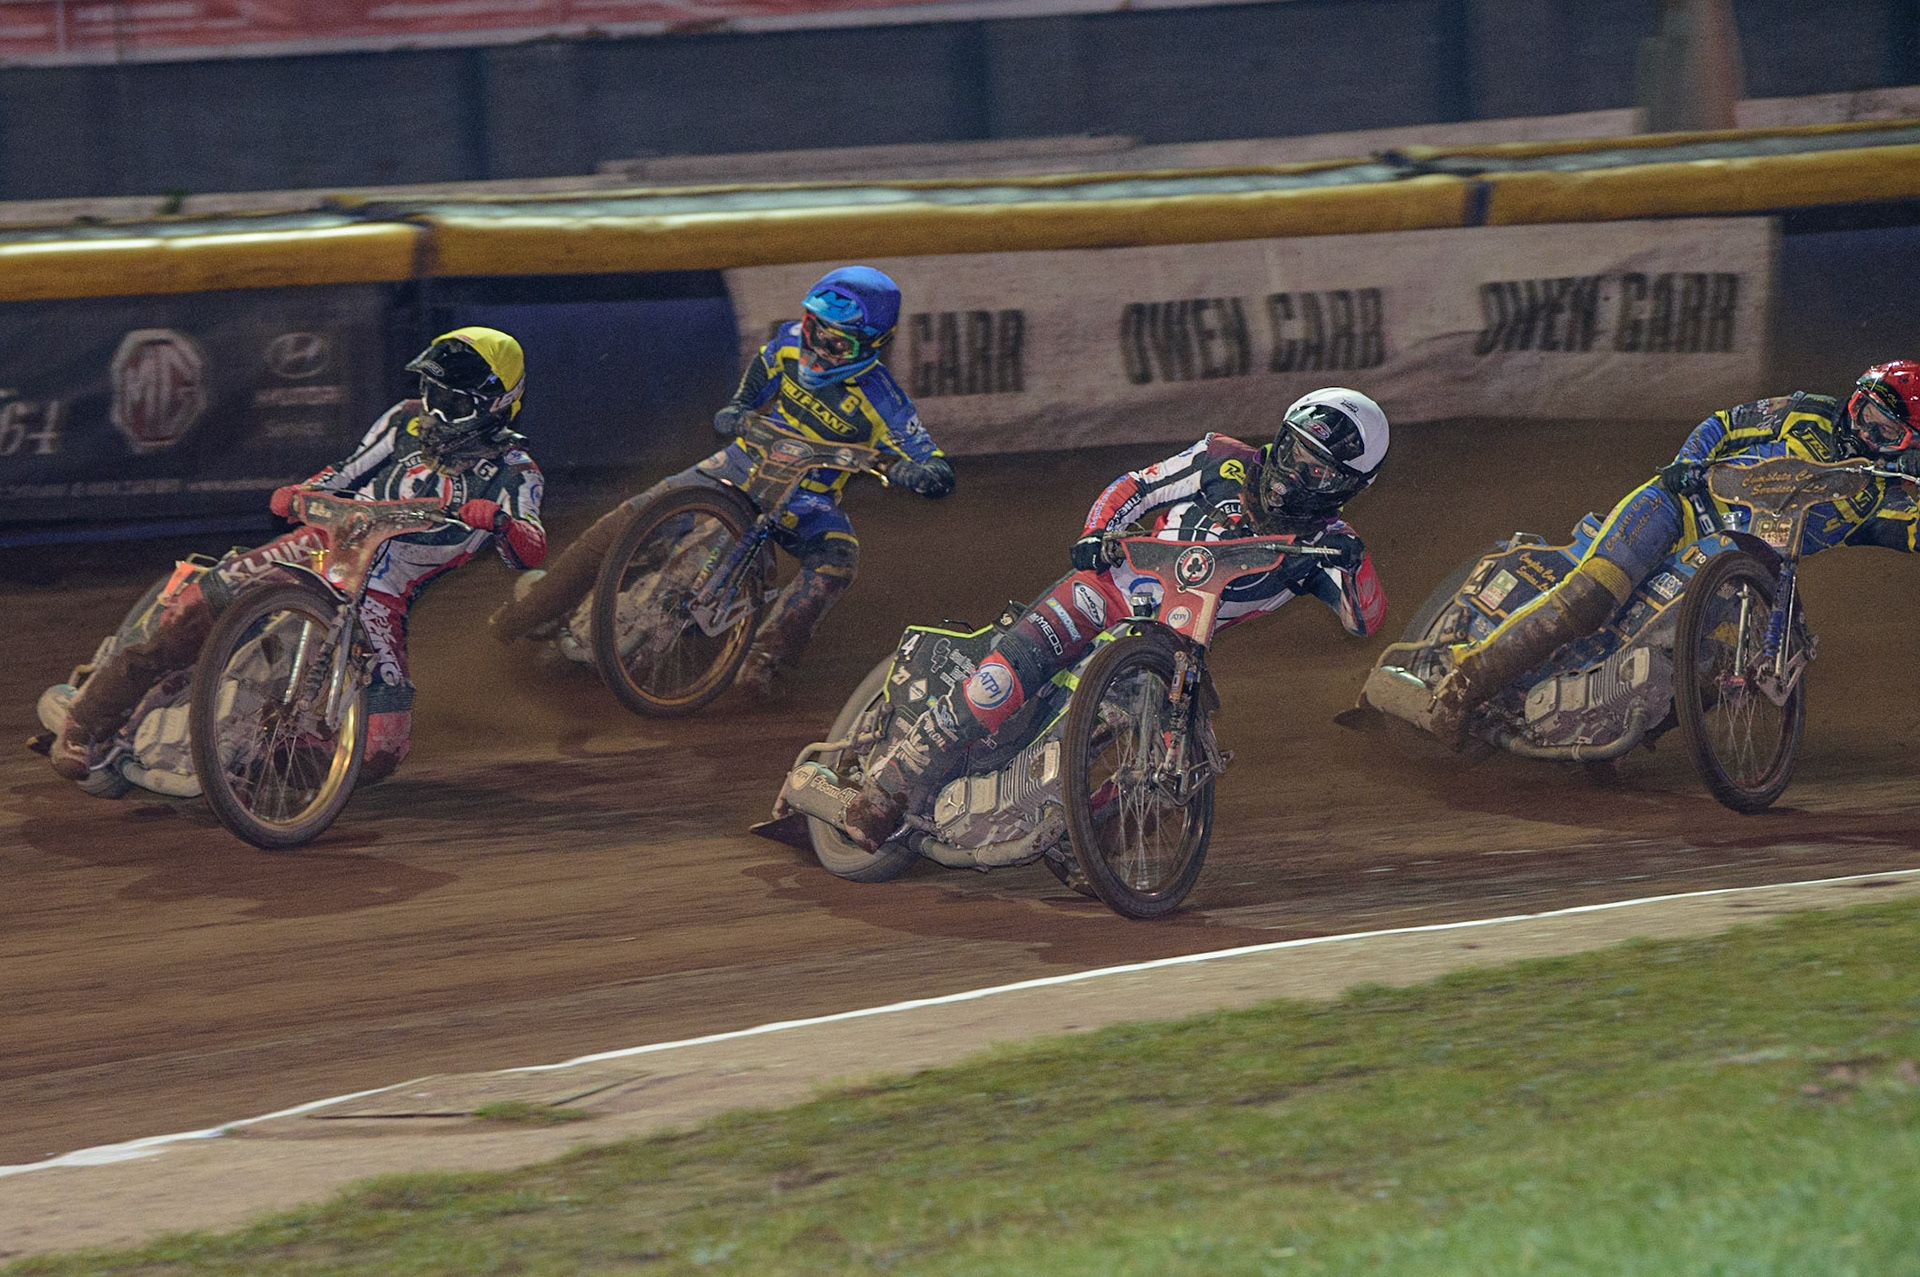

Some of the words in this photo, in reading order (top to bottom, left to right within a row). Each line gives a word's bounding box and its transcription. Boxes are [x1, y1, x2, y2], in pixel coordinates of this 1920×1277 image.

[1120, 297, 1250, 385] OWEN
[1267, 286, 1385, 374] CARR
[800, 395, 852, 434] PLANT
[980, 671, 1002, 699] ATPI
